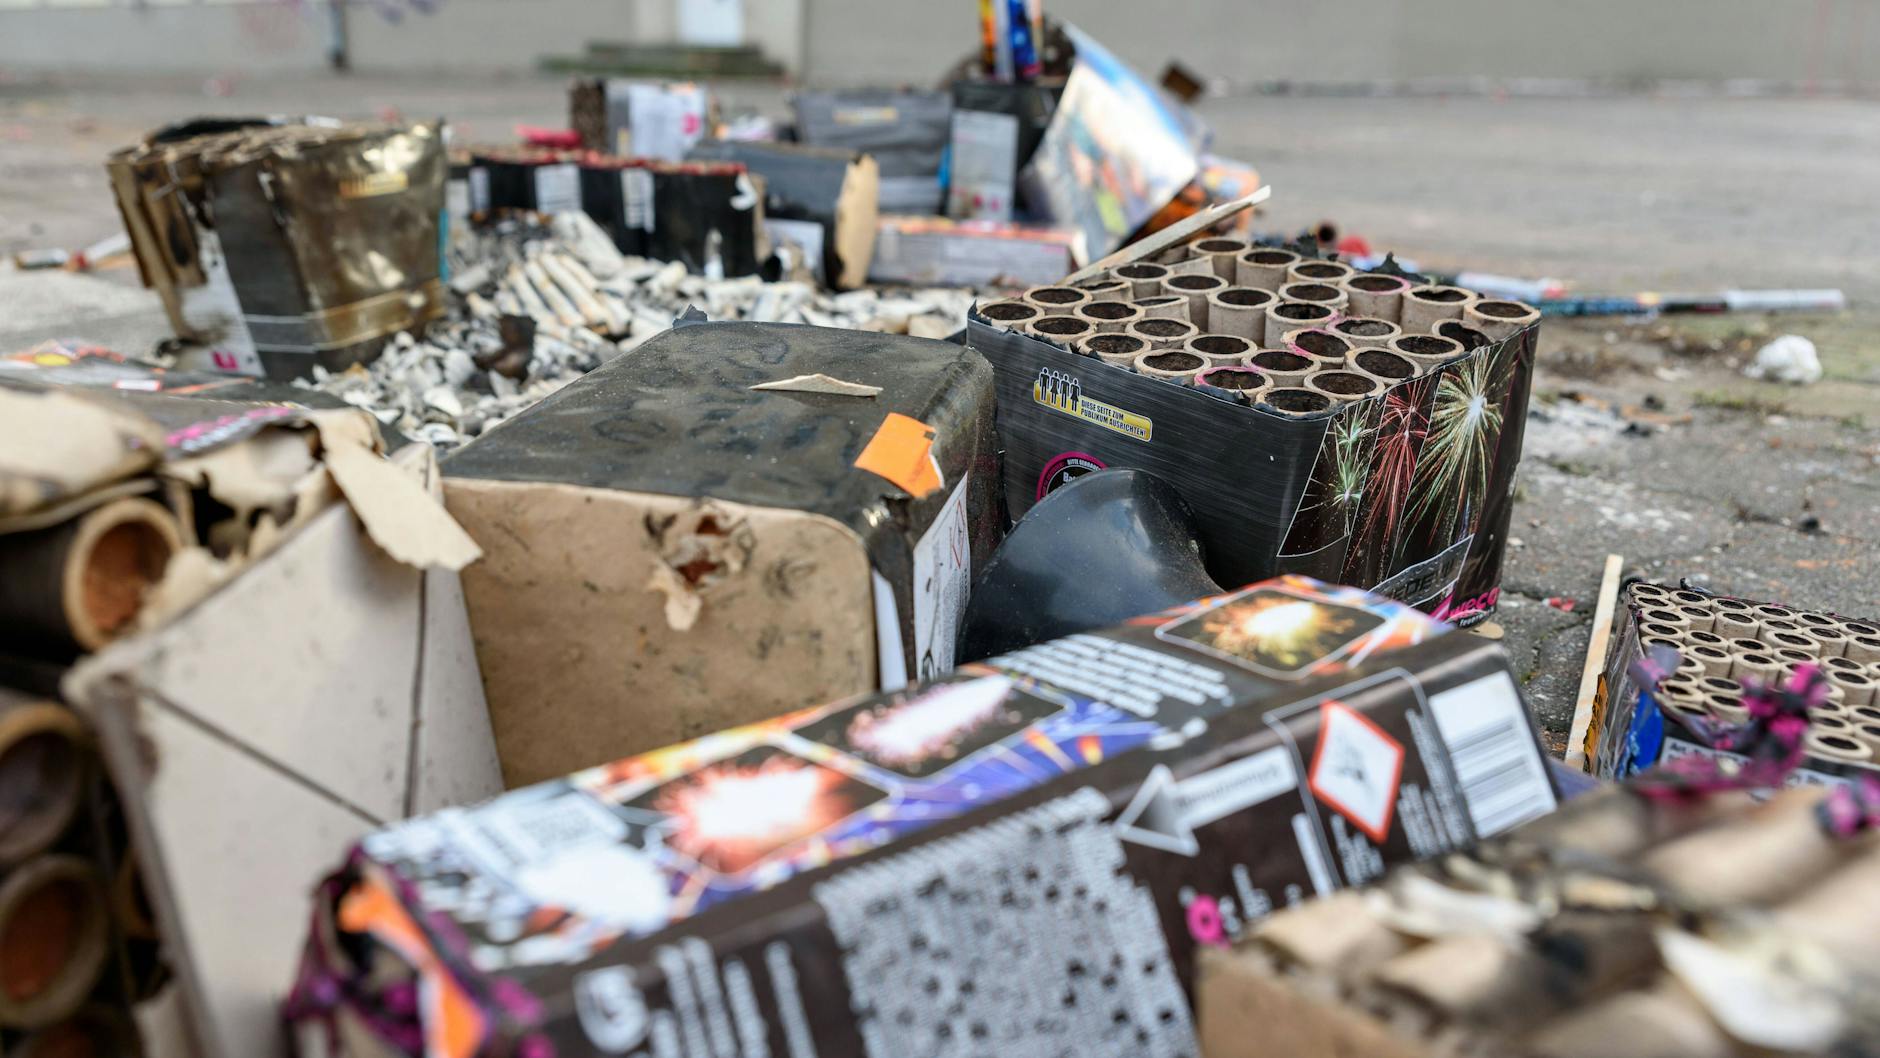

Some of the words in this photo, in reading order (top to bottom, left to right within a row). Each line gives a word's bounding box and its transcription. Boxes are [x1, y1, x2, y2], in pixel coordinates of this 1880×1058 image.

[1081, 399, 1096, 411] DIESE
[1097, 404, 1112, 417] SEITE
[1112, 410, 1124, 421] ZUM
[1081, 408, 1108, 423] PUBLIKUM
